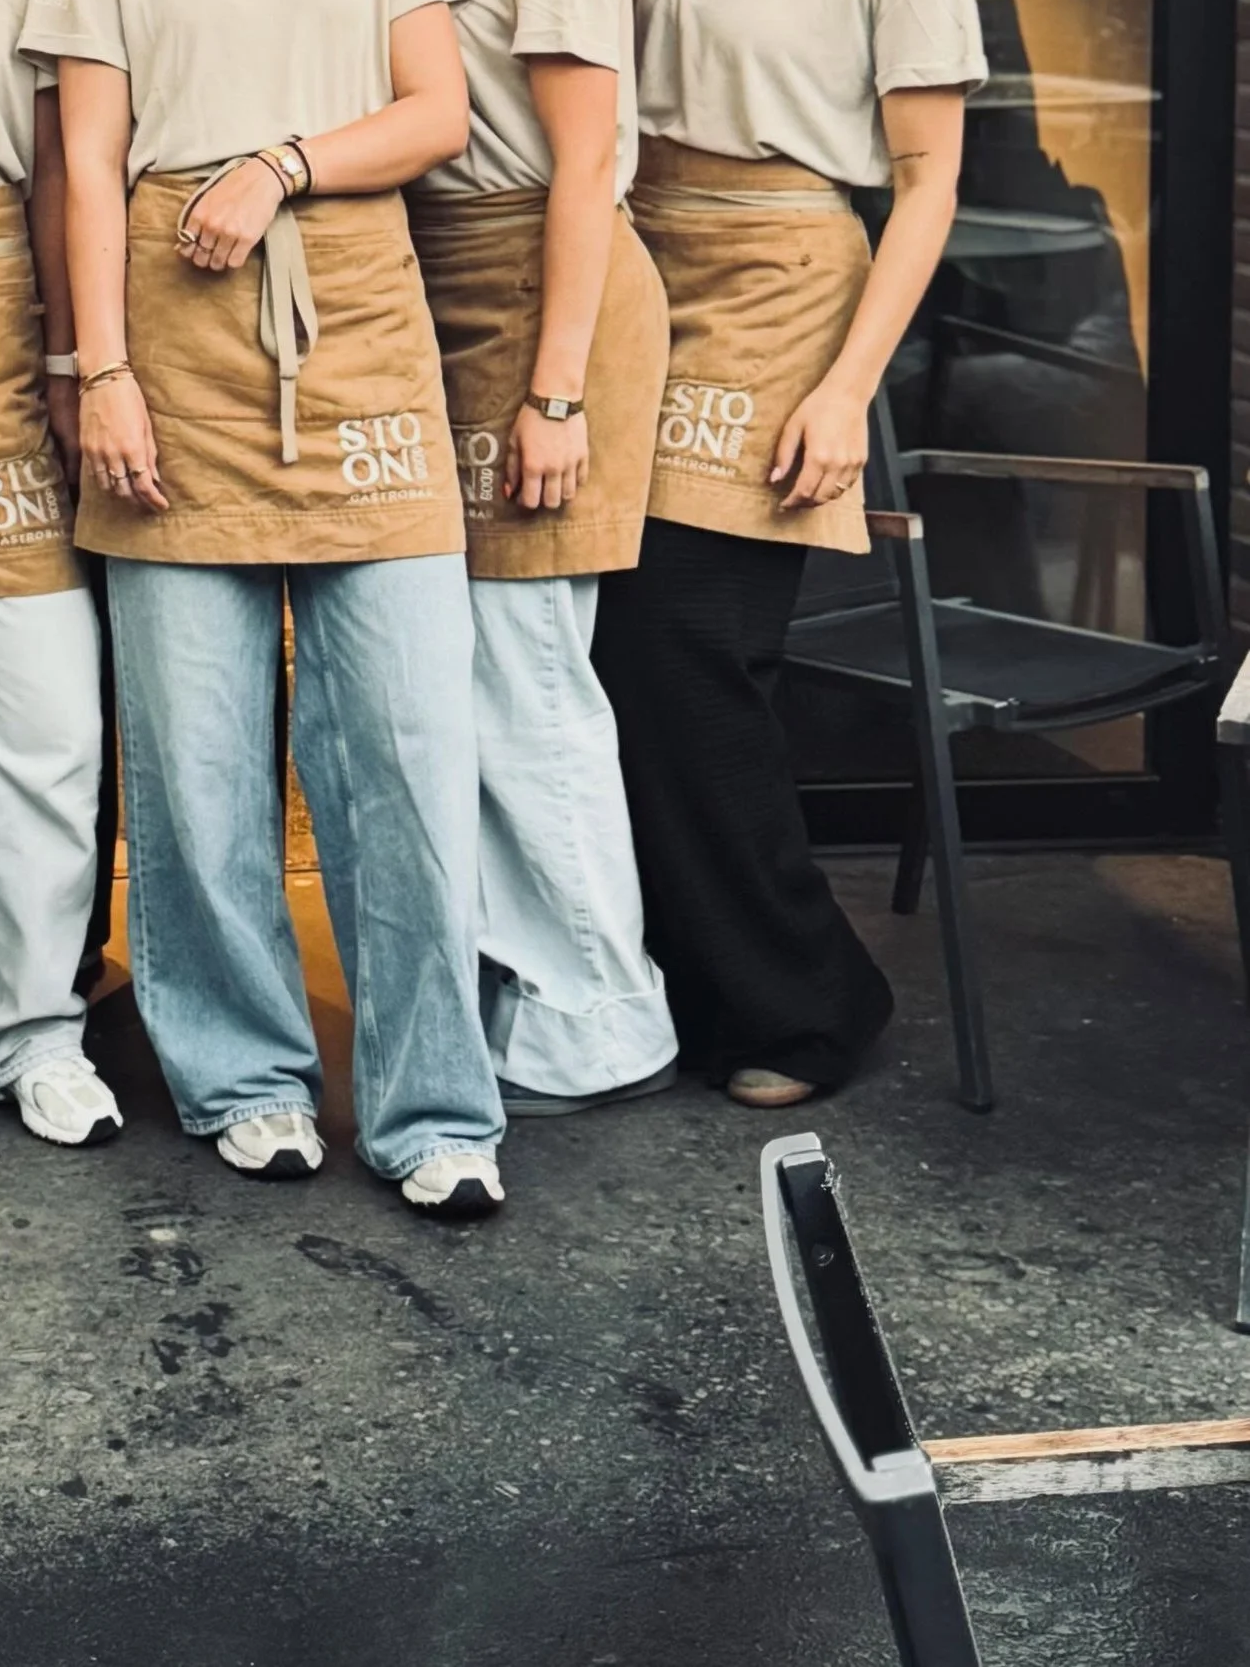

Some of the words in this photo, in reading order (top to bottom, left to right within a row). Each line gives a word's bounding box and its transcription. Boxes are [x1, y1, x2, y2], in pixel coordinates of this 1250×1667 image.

[668, 384, 754, 426] STO
[337, 412, 422, 453] STO
[661, 415, 728, 459] ON
[342, 446, 414, 488] ON
